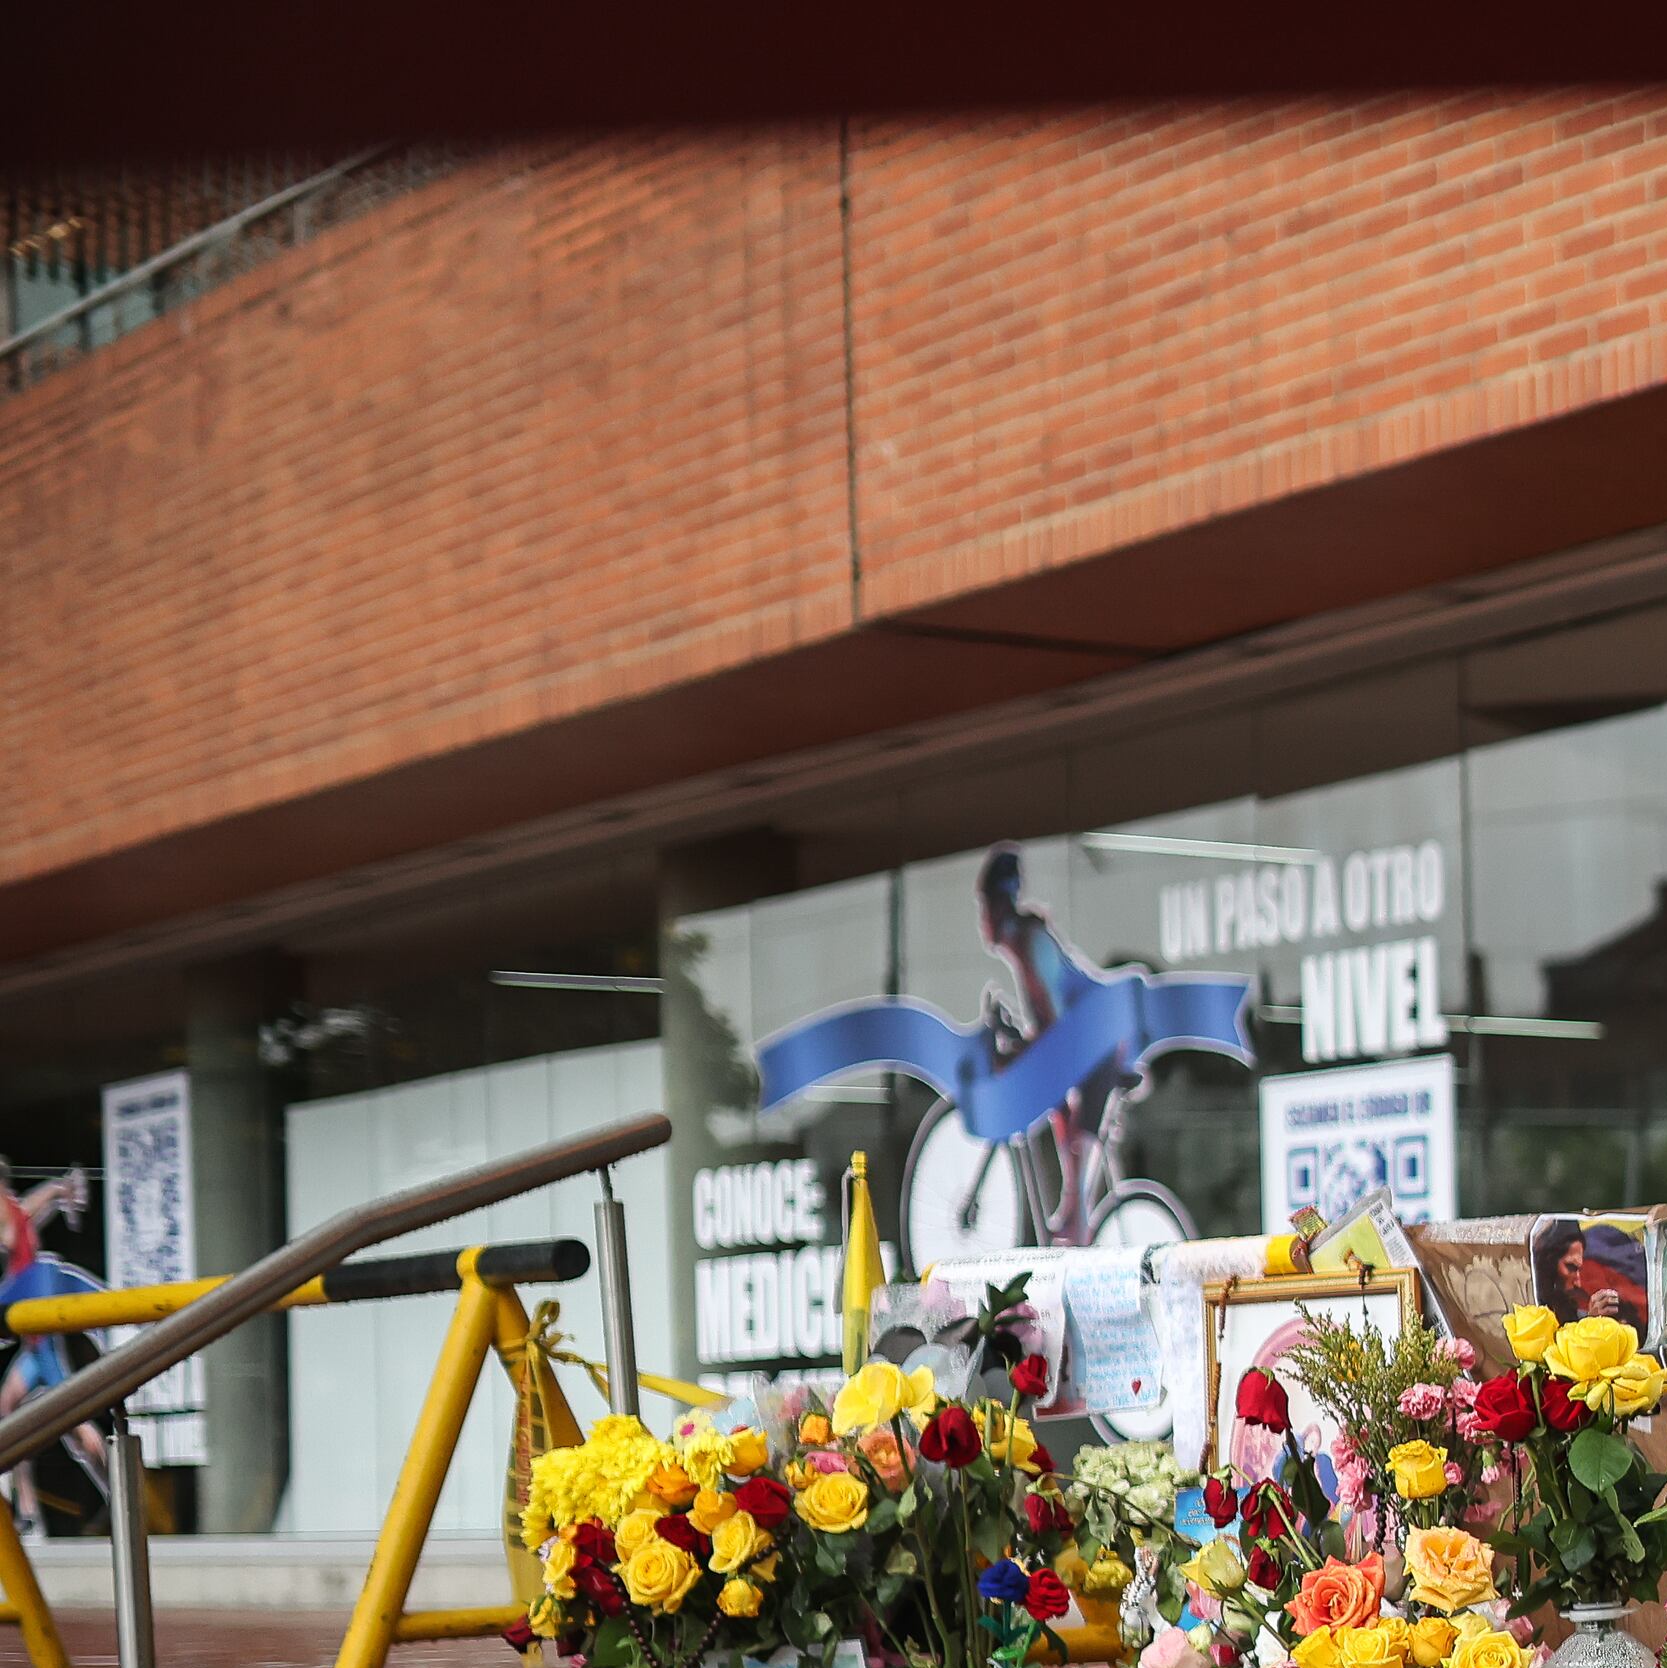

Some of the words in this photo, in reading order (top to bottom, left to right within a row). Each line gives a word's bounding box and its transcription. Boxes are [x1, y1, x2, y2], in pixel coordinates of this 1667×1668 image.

[1159, 880, 1205, 957] UN
[1216, 862, 1306, 954] PASO
[1310, 854, 1344, 938] A
[1345, 839, 1444, 933] OTRO
[1302, 936, 1450, 1064] NIVEL
[695, 1241, 898, 1365] MEDICI
